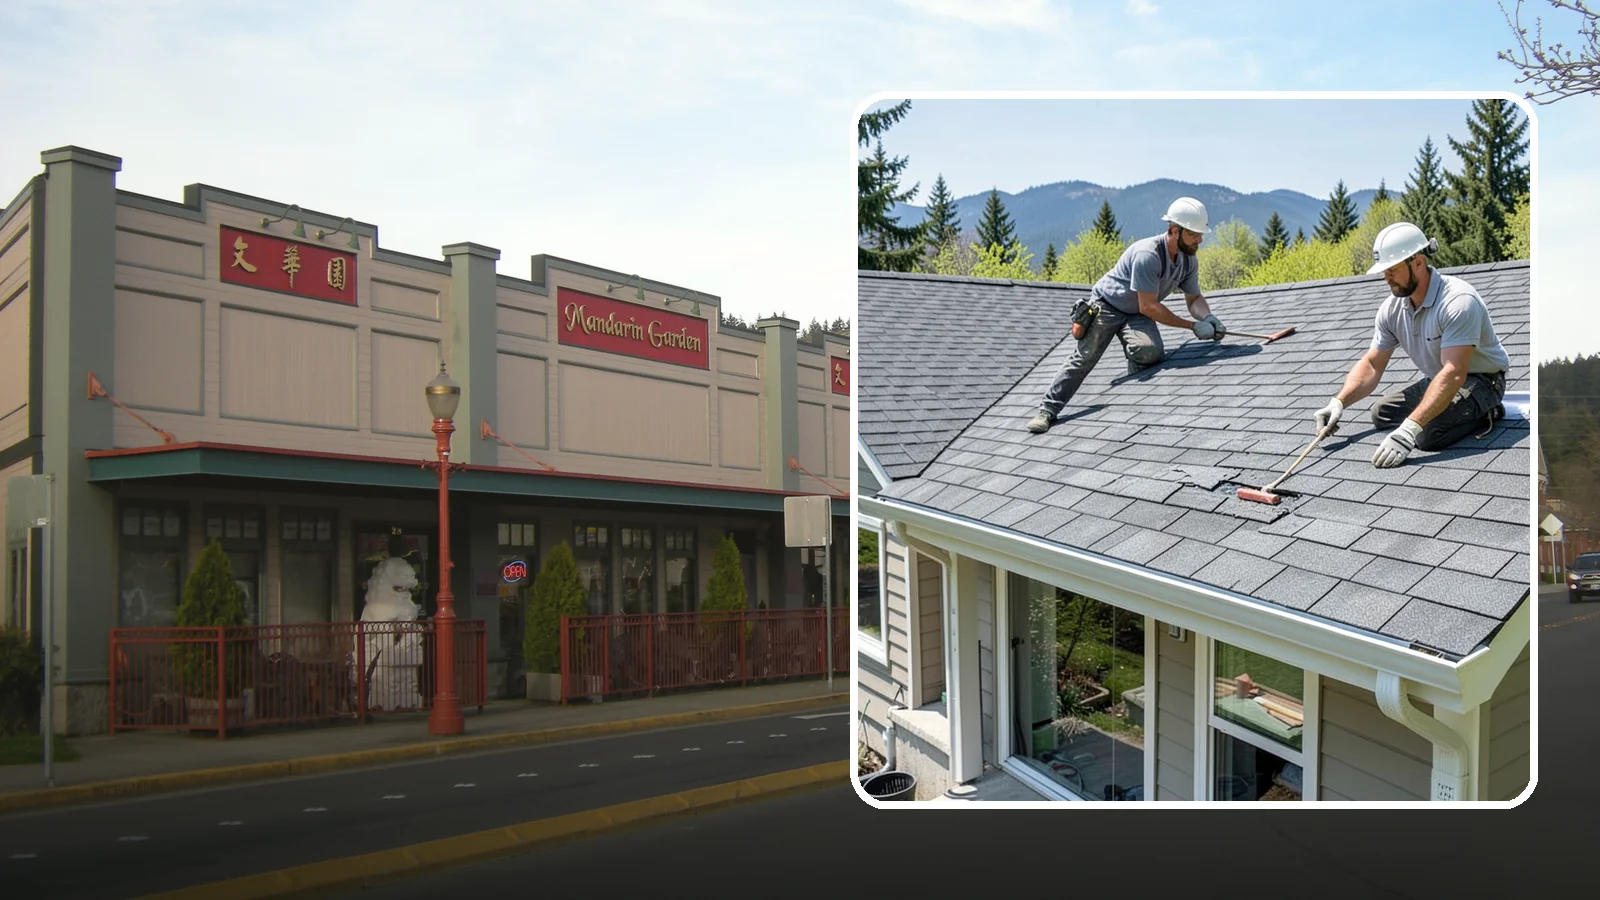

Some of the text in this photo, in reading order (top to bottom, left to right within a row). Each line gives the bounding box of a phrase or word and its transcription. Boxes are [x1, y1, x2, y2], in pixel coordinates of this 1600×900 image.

[230, 235, 346, 290] 文華園
[564, 302, 701, 352] Mandarin Garden
[503, 565, 527, 578] OPEN
